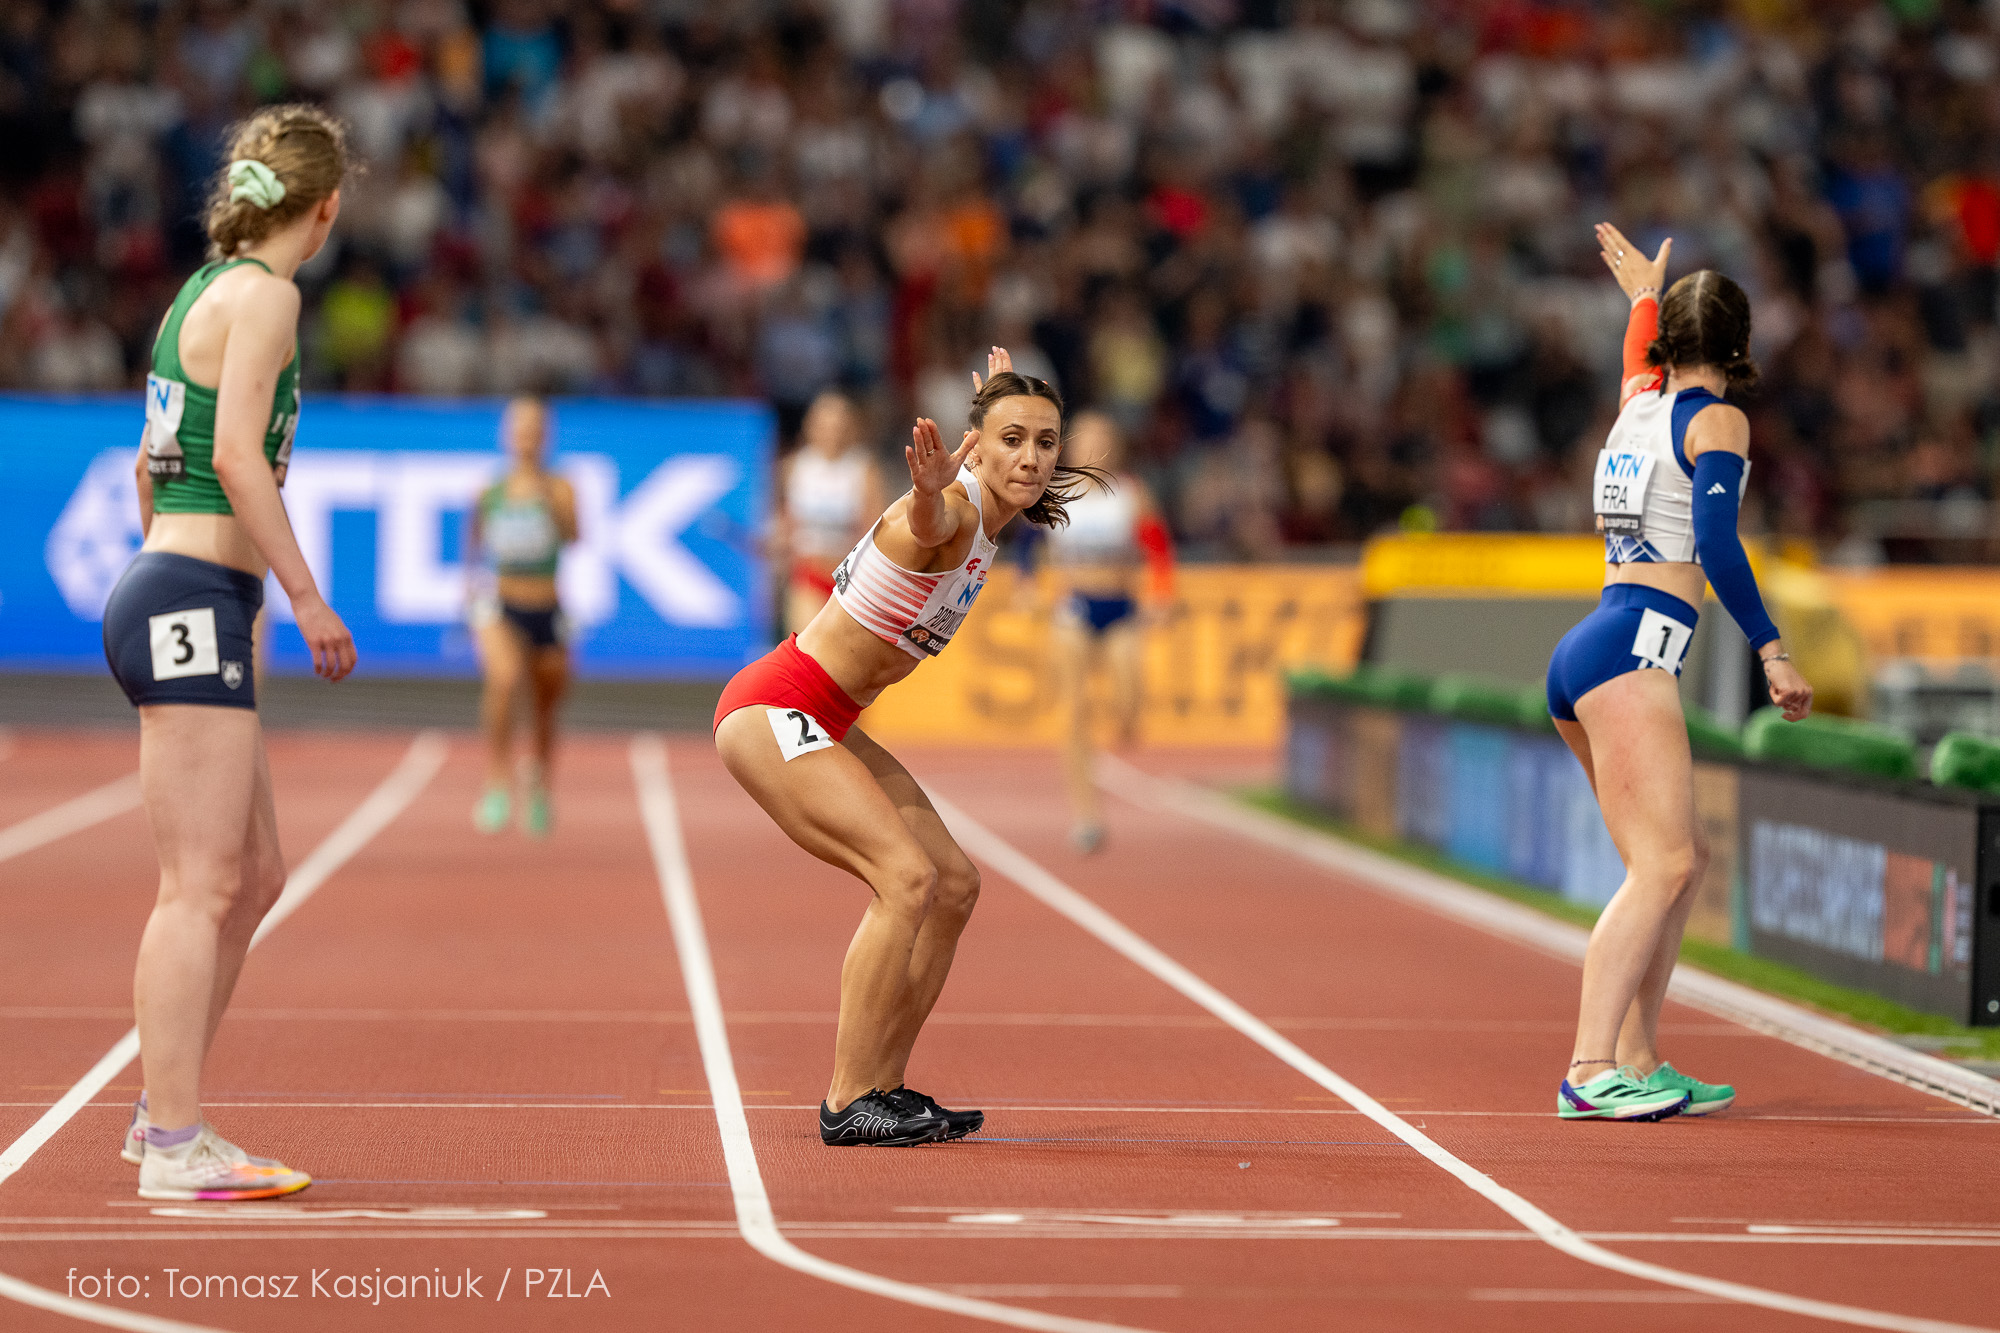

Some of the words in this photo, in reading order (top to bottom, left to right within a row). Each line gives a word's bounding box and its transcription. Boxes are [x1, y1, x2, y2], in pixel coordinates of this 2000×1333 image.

[1604, 453, 1645, 478] NTN
[1602, 484, 1628, 510] FRA
[171, 623, 194, 665] 3
[1658, 625, 1673, 659] 1
[787, 710, 819, 747] 2
[838, 1111, 898, 1138] AIR
